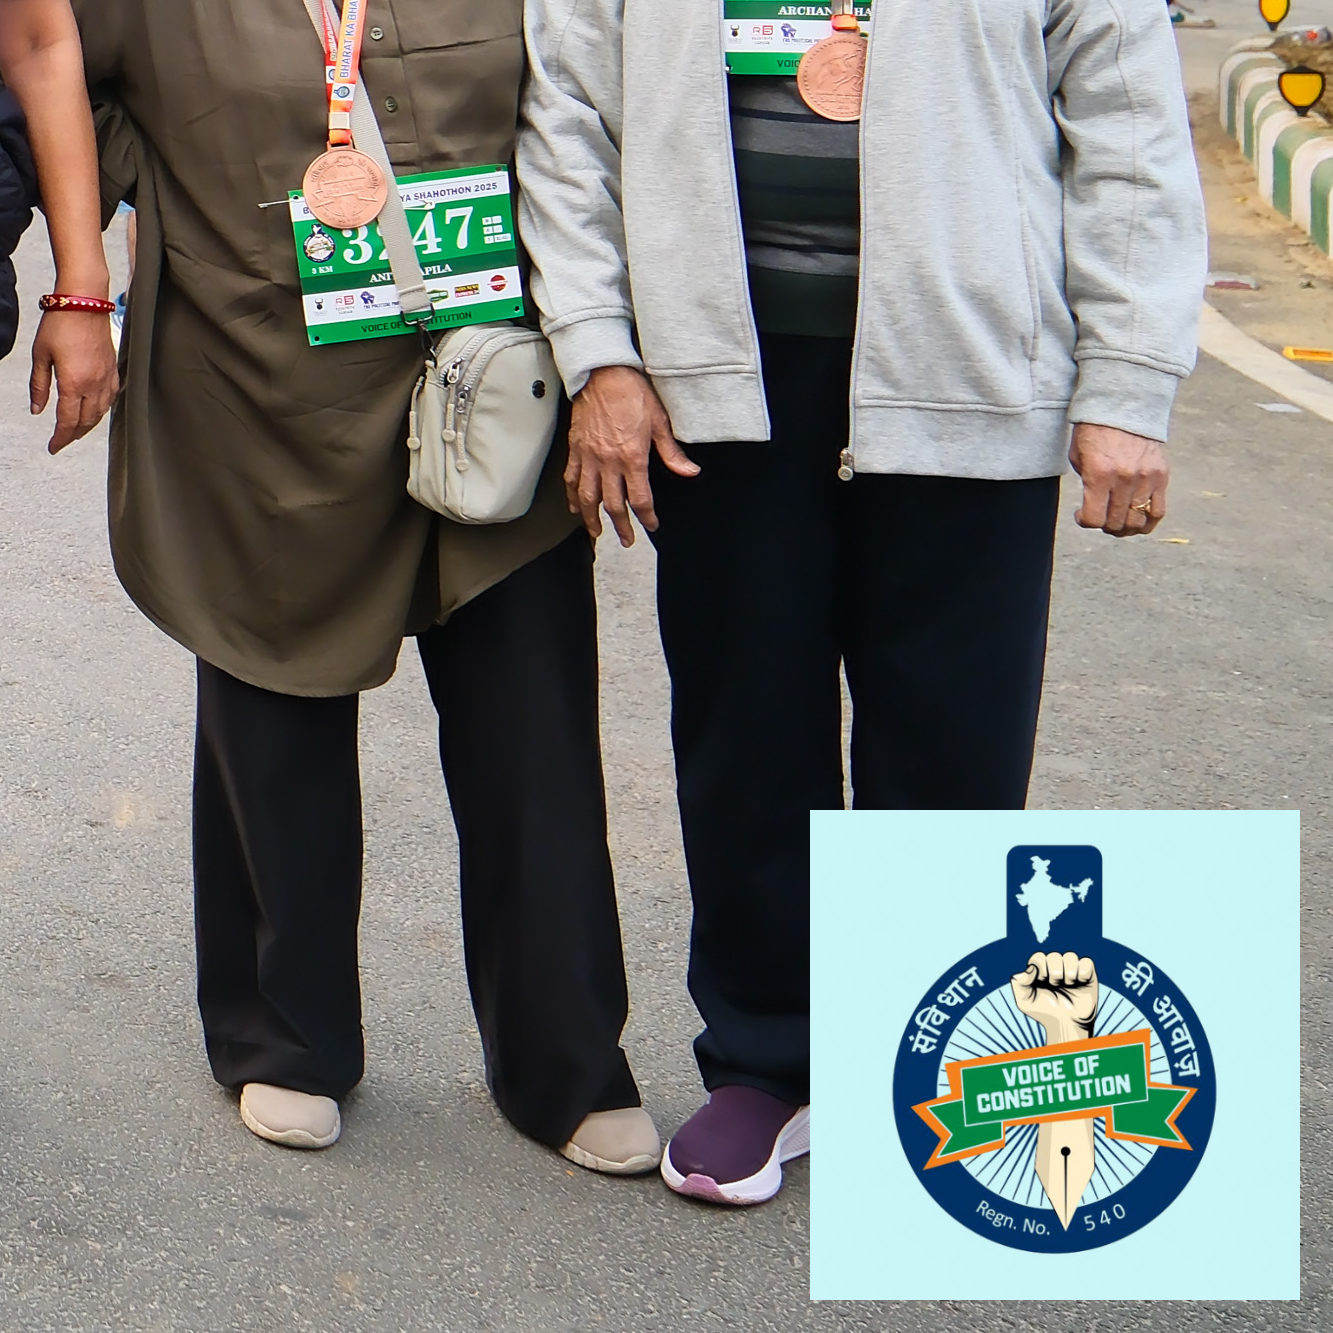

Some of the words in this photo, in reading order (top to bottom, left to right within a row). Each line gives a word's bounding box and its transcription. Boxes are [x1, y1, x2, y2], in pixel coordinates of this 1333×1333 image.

[777, 6, 832, 16] ARCHAN
[345, 20, 356, 38] KA
[340, 38, 353, 79] BHARAT
[413, 186, 472, 201] SHAHOTHON
[474, 182, 498, 192] 2025
[319, 265, 334, 274] KM
[361, 322, 389, 333] VOICE
[390, 320, 402, 330] OF
